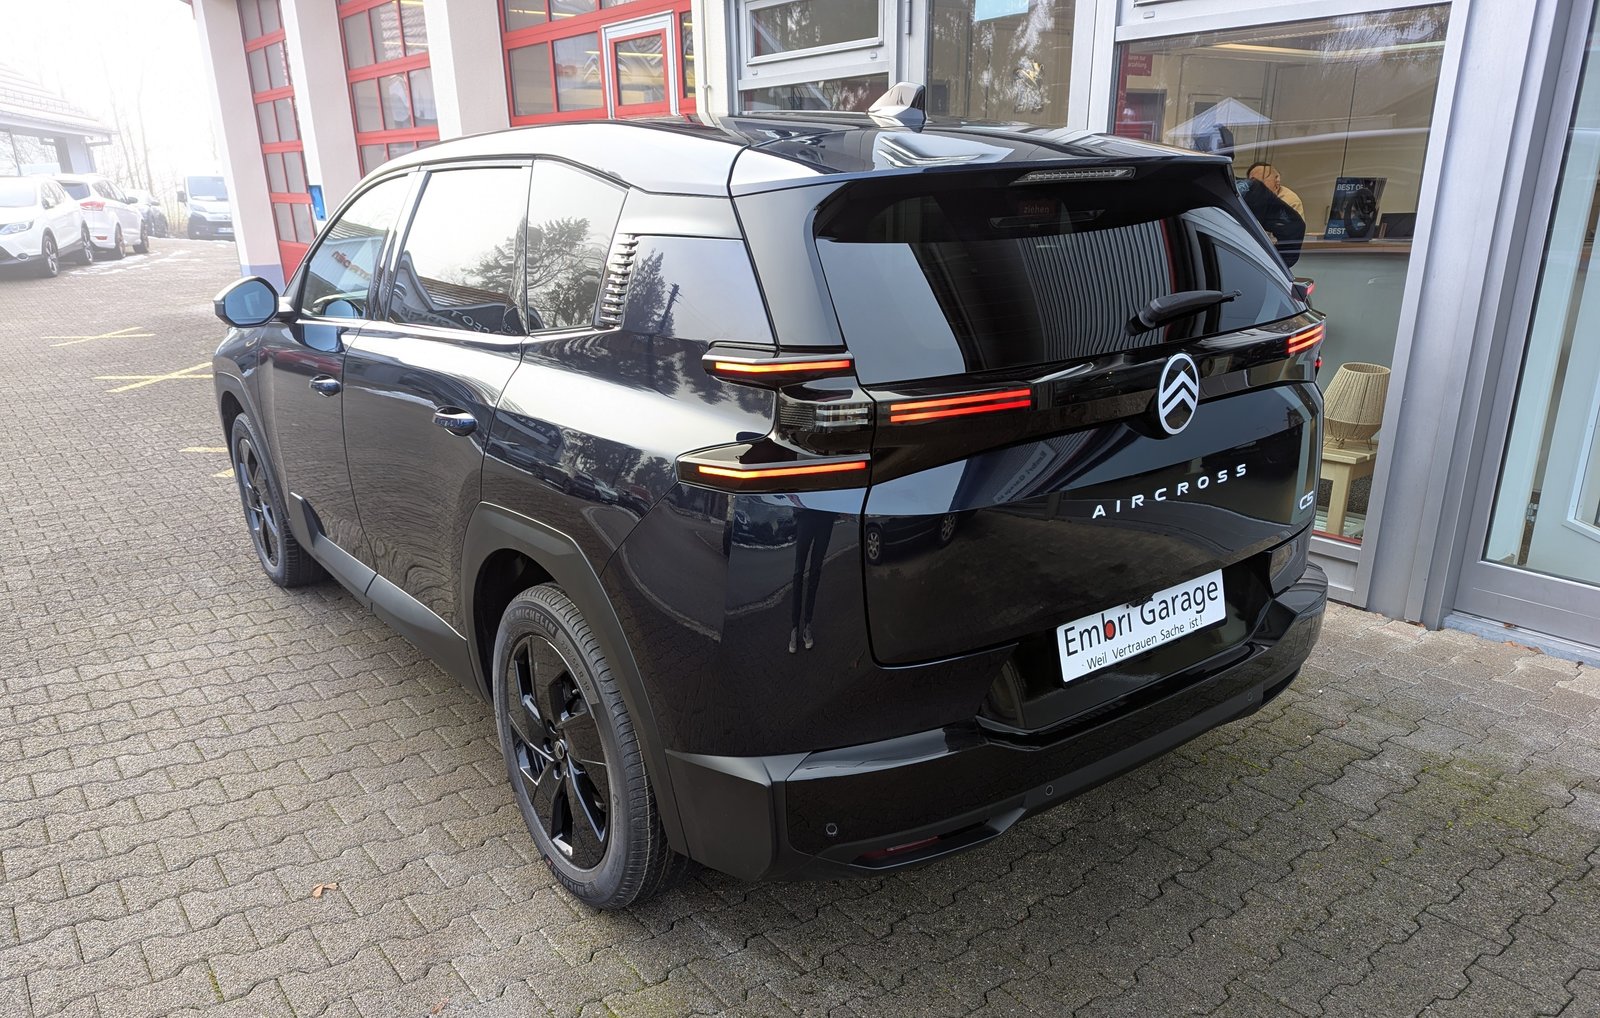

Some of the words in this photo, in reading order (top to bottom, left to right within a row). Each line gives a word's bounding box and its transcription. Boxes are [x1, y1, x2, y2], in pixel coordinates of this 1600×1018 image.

[1336, 183, 1356, 191] BEST
[1023, 203, 1050, 215] ziehen
[1327, 227, 1346, 235] BEST
[1091, 463, 1247, 519] AIRCROSS
[1299, 490, 1315, 511] C5
[515, 607, 558, 638] MICHELIN
[1063, 604, 1133, 657] Embri
[1139, 580, 1219, 626] Garage
[1086, 652, 1108, 670] Weil
[1111, 633, 1158, 660] Vertrauen
[1159, 623, 1185, 641] Sache
